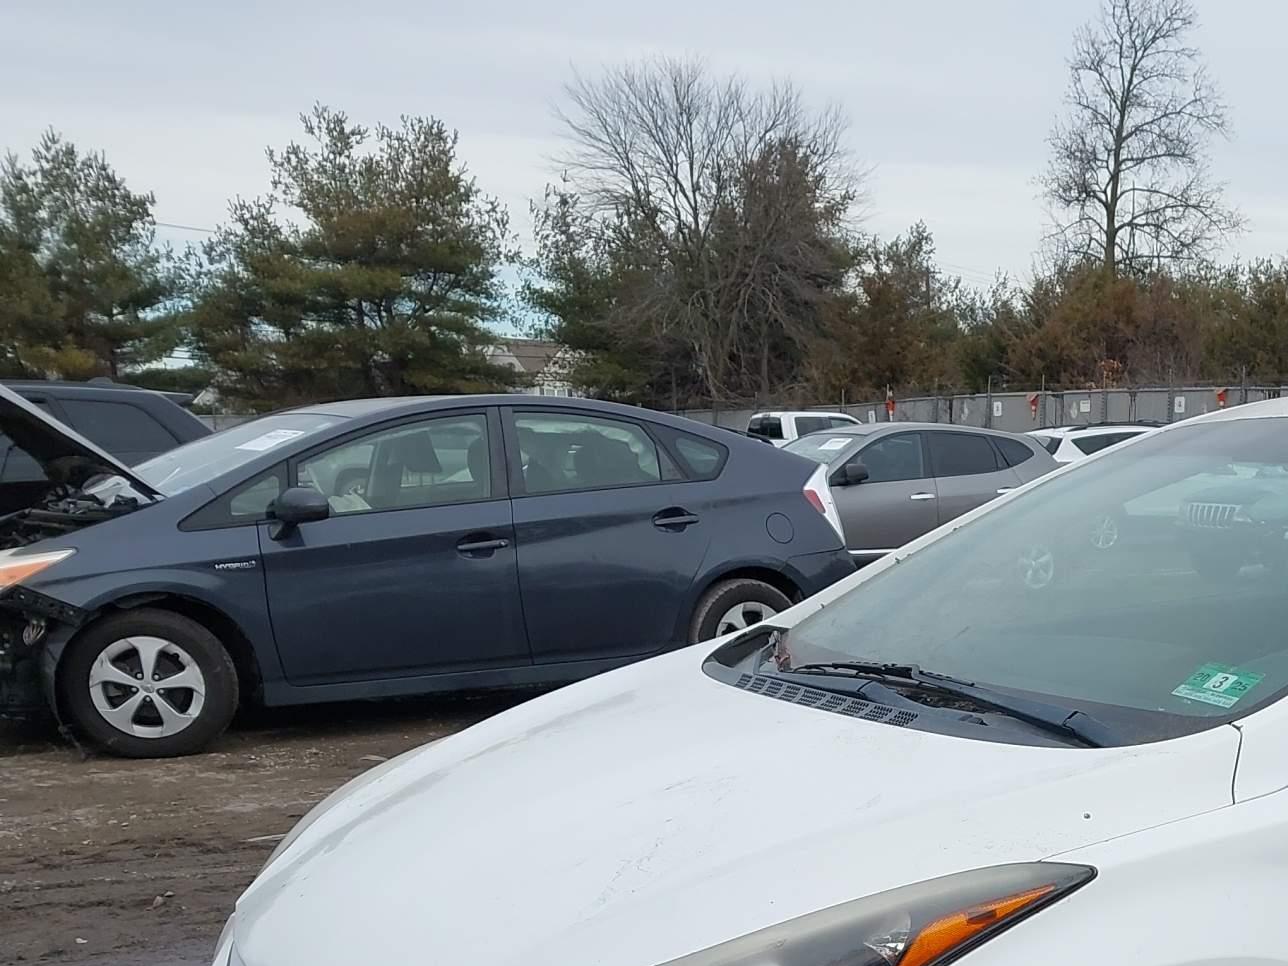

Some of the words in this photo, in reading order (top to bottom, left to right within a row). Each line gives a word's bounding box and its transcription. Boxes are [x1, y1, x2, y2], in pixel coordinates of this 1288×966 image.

[1193, 672, 1211, 682] 20
[1212, 676, 1229, 689] 3
[1231, 681, 1250, 691] 25
